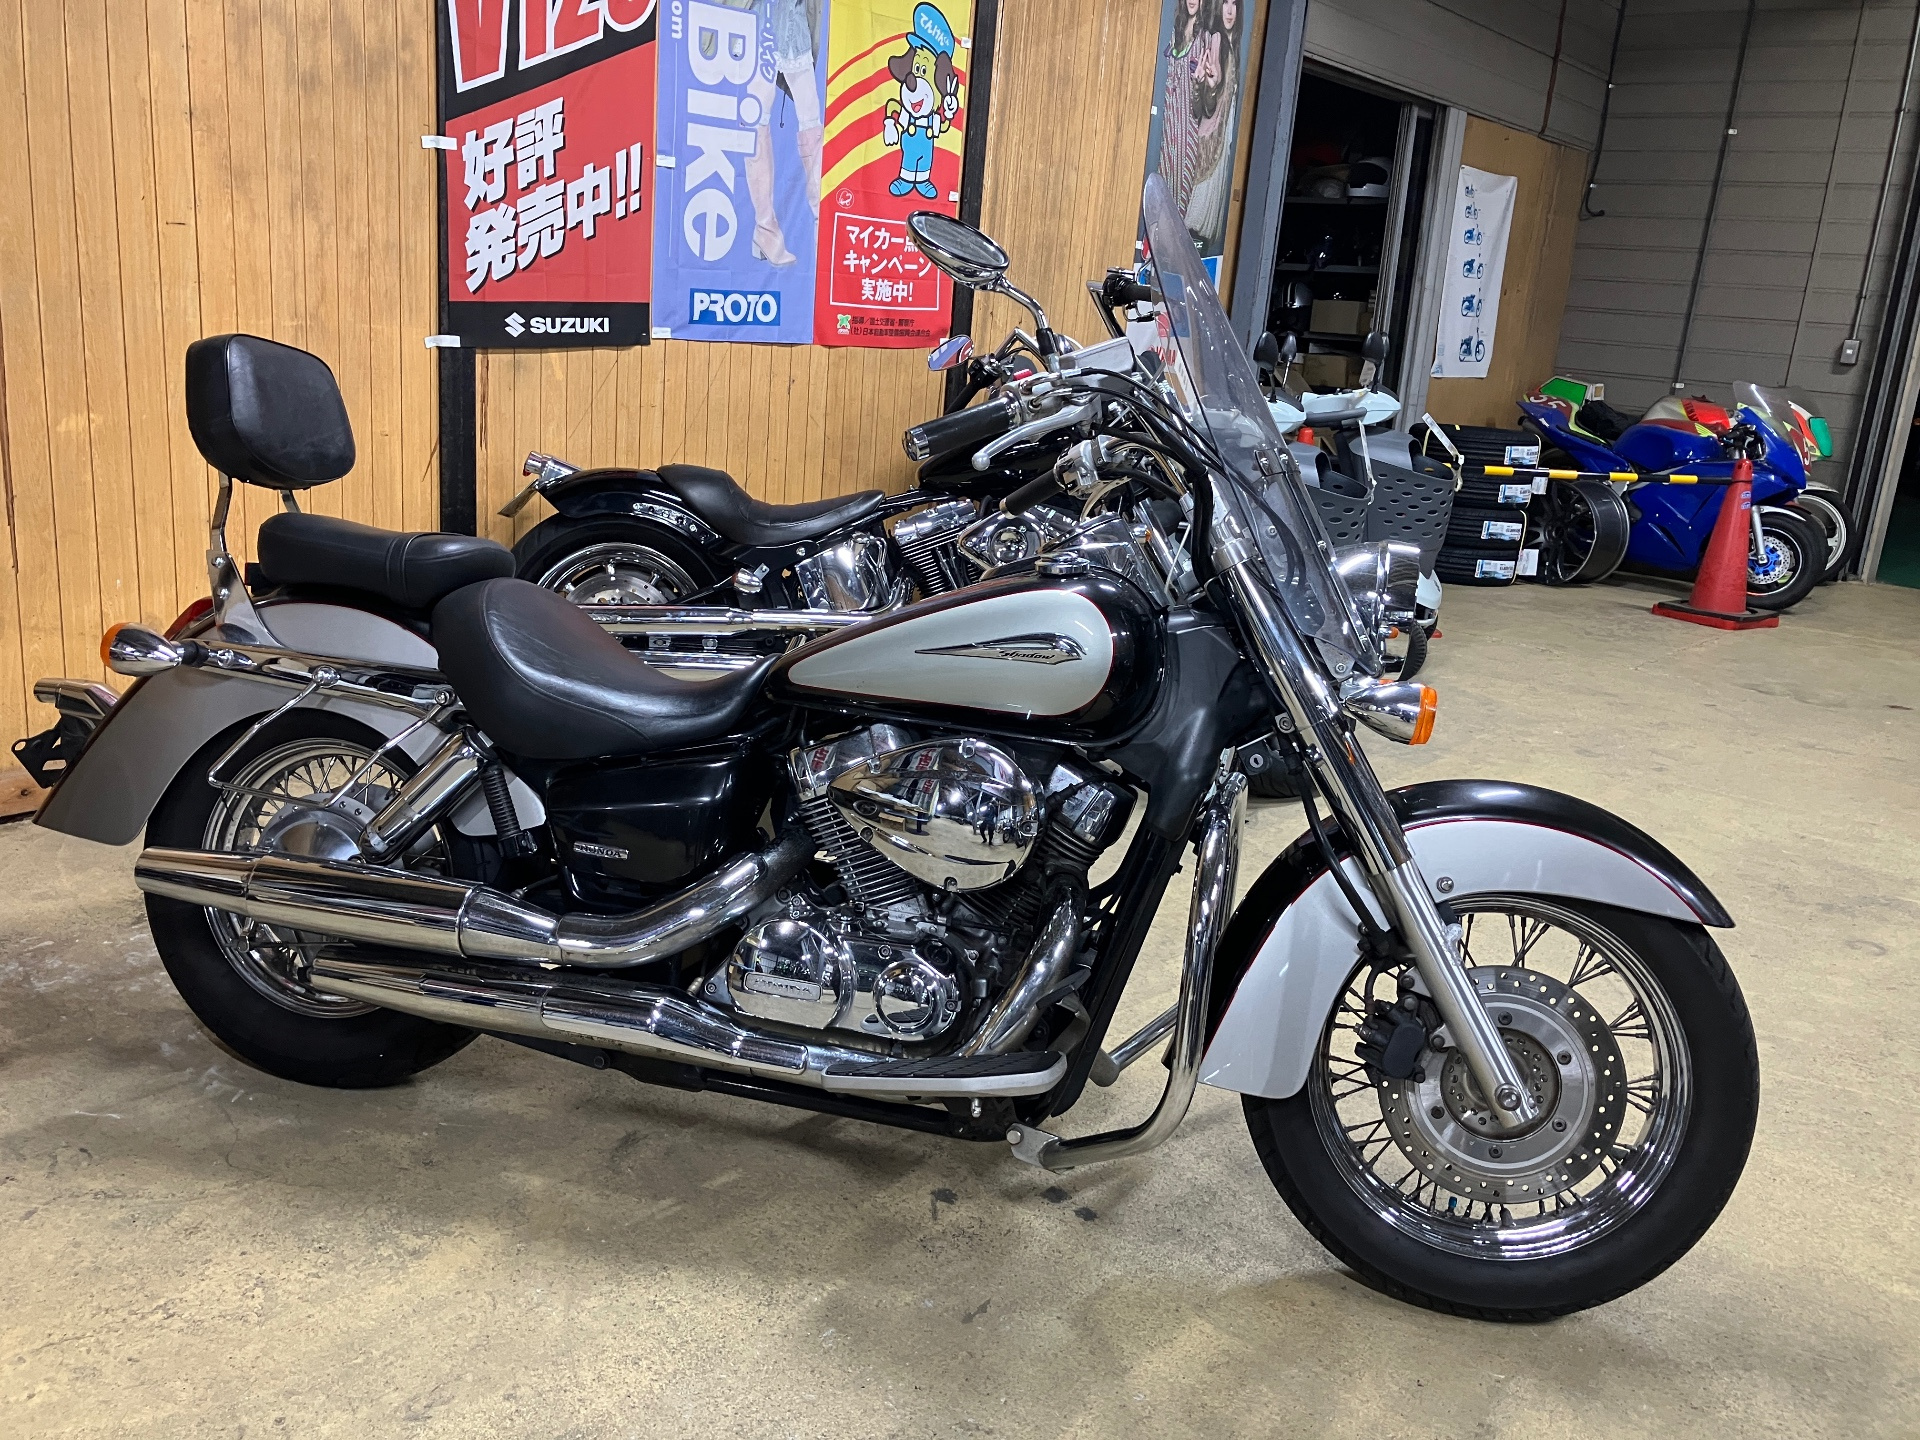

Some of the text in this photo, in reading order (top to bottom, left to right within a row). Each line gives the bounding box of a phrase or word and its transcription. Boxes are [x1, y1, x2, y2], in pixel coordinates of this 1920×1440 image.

[684, 1, 760, 262] Bike
[462, 97, 565, 211] 好評
[843, 250, 931, 277] キャンペーン
[861, 277, 913, 303] 実施中!
[693, 292, 778, 322] PROTO
[530, 317, 609, 333] SUZUKI
